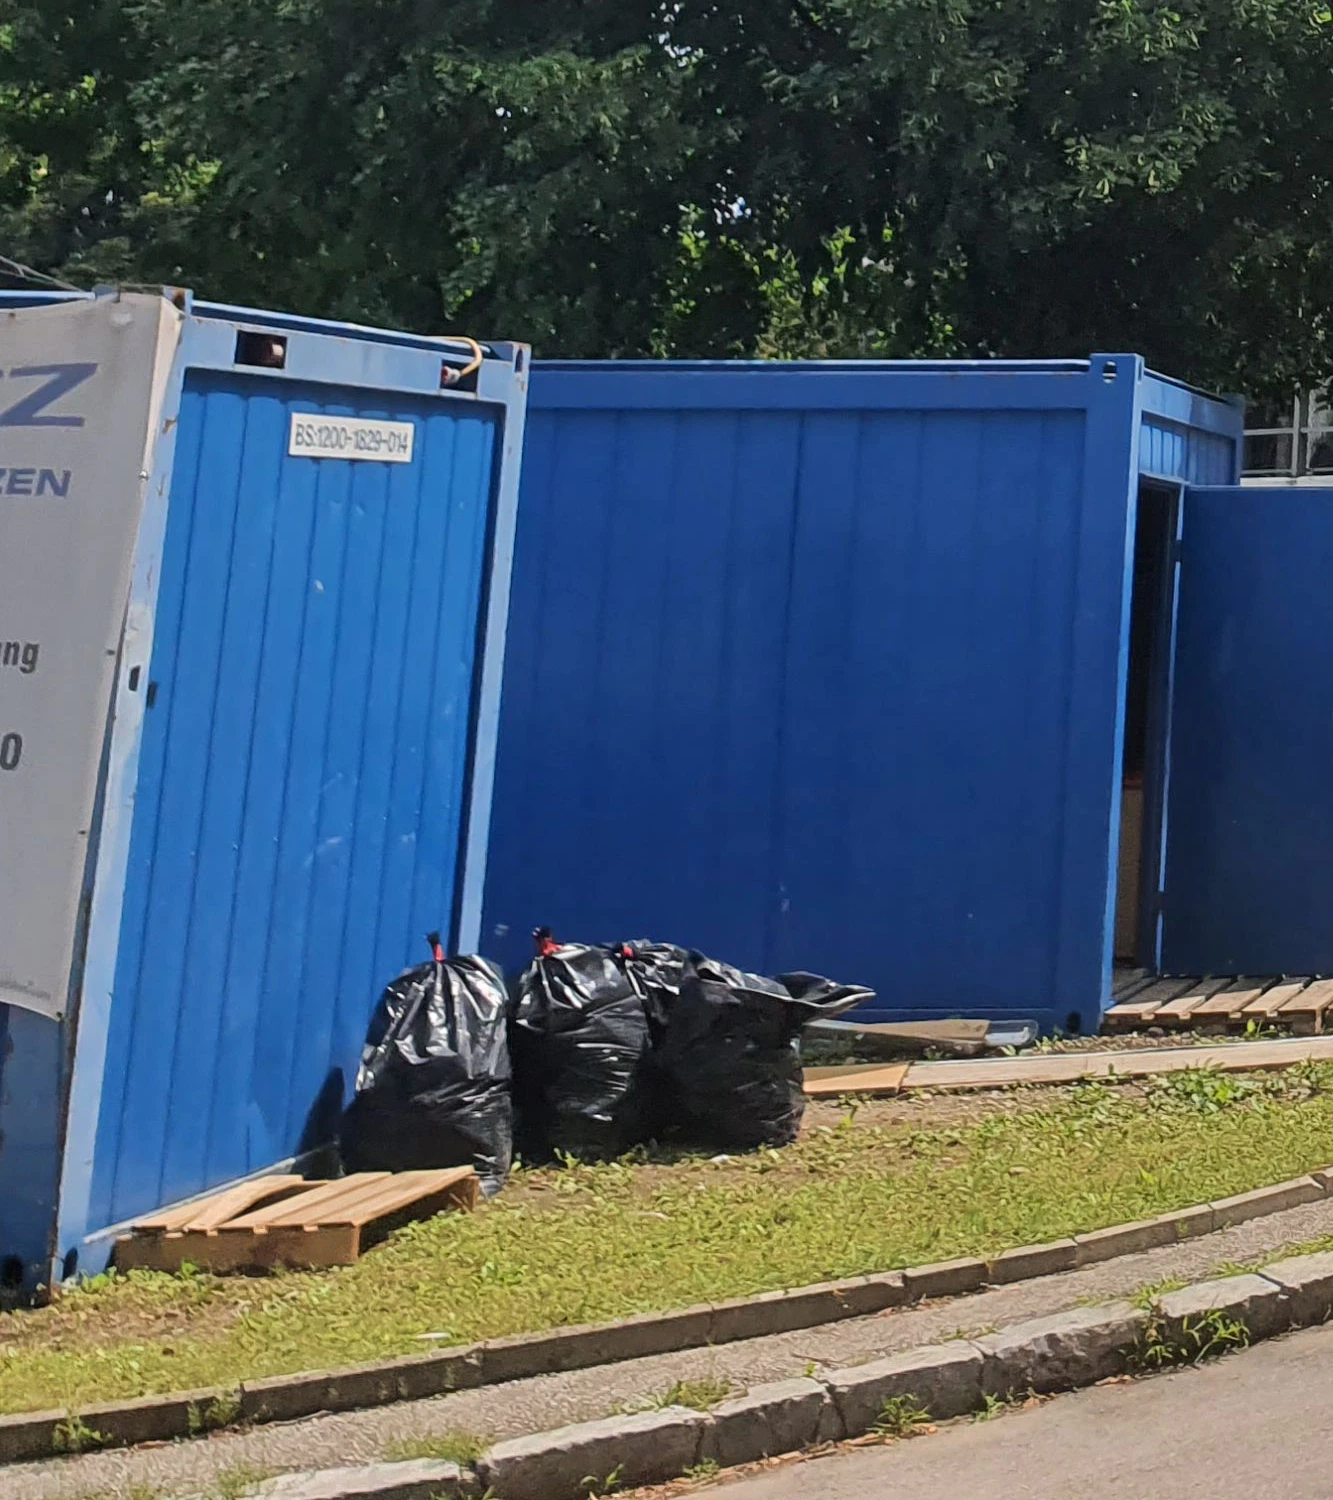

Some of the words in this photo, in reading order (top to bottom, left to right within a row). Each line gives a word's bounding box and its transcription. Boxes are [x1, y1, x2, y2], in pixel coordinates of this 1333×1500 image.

[0, 363, 98, 427] Z
[0, 467, 72, 497] EN
[0, 641, 40, 674] ng
